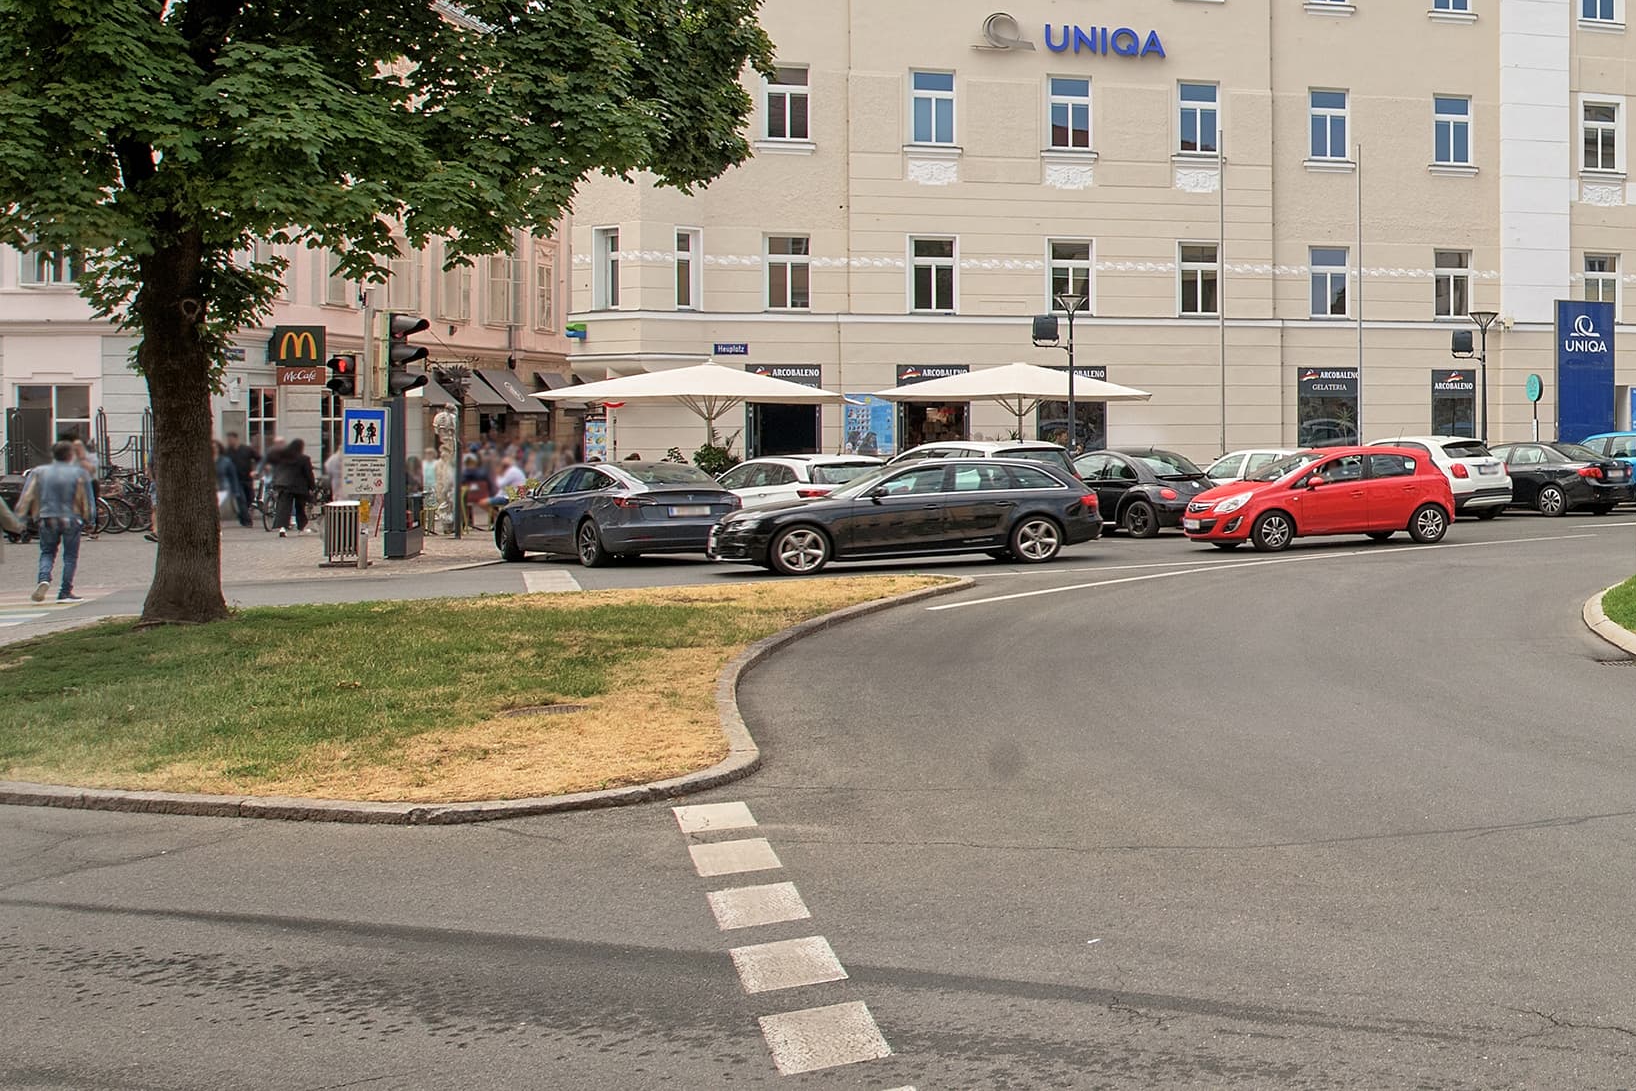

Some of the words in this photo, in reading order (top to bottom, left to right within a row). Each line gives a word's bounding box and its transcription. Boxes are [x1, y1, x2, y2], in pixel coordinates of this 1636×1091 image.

[1044, 23, 1166, 59] UNIQA
[717, 344, 745, 354] Heuplatz
[1564, 339, 1608, 353] UNIQA
[771, 368, 820, 377] ARCOBALENO
[1319, 371, 1360, 379] ARCOBALENO
[1311, 383, 1348, 391] GELATERIA
[1433, 382, 1474, 390] ARCOBALENO
